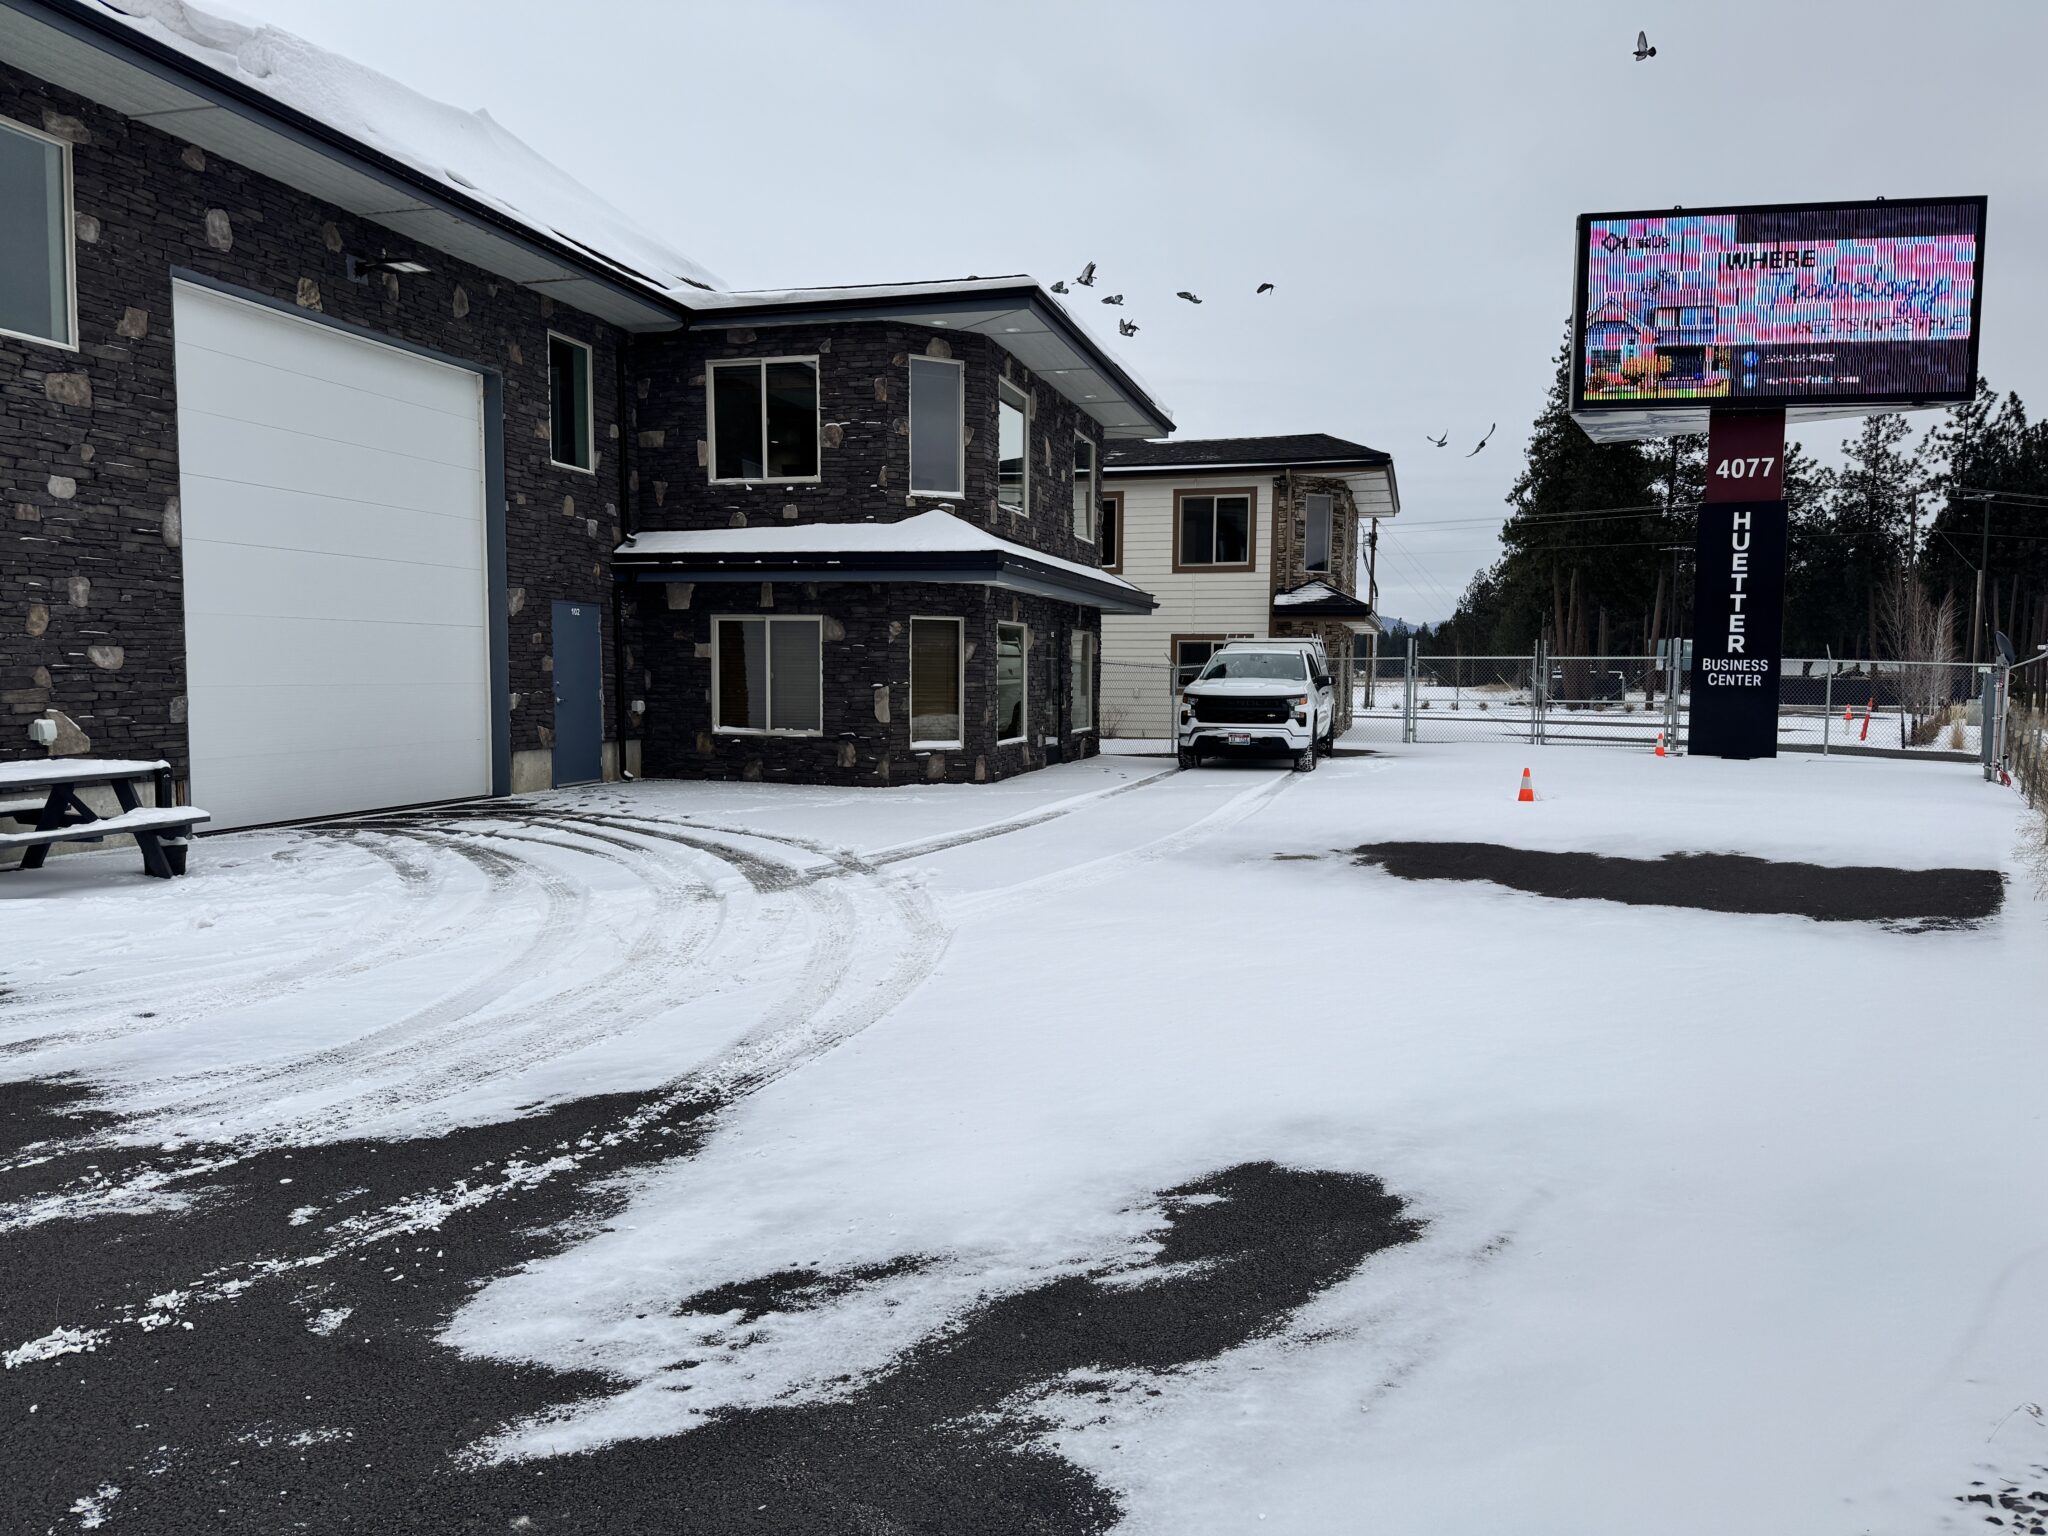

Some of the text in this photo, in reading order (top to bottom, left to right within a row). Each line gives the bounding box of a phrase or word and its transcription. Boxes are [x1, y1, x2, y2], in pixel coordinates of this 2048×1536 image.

[1725, 250, 1815, 270] WHERE
[1769, 271, 1949, 315] Technology
[1715, 457, 1775, 479] 4077
[1727, 511, 1751, 653] HUETTER
[571, 607, 581, 616] 102
[1702, 657, 1769, 671] BUSINESS
[1707, 672, 1762, 686] CENTER
